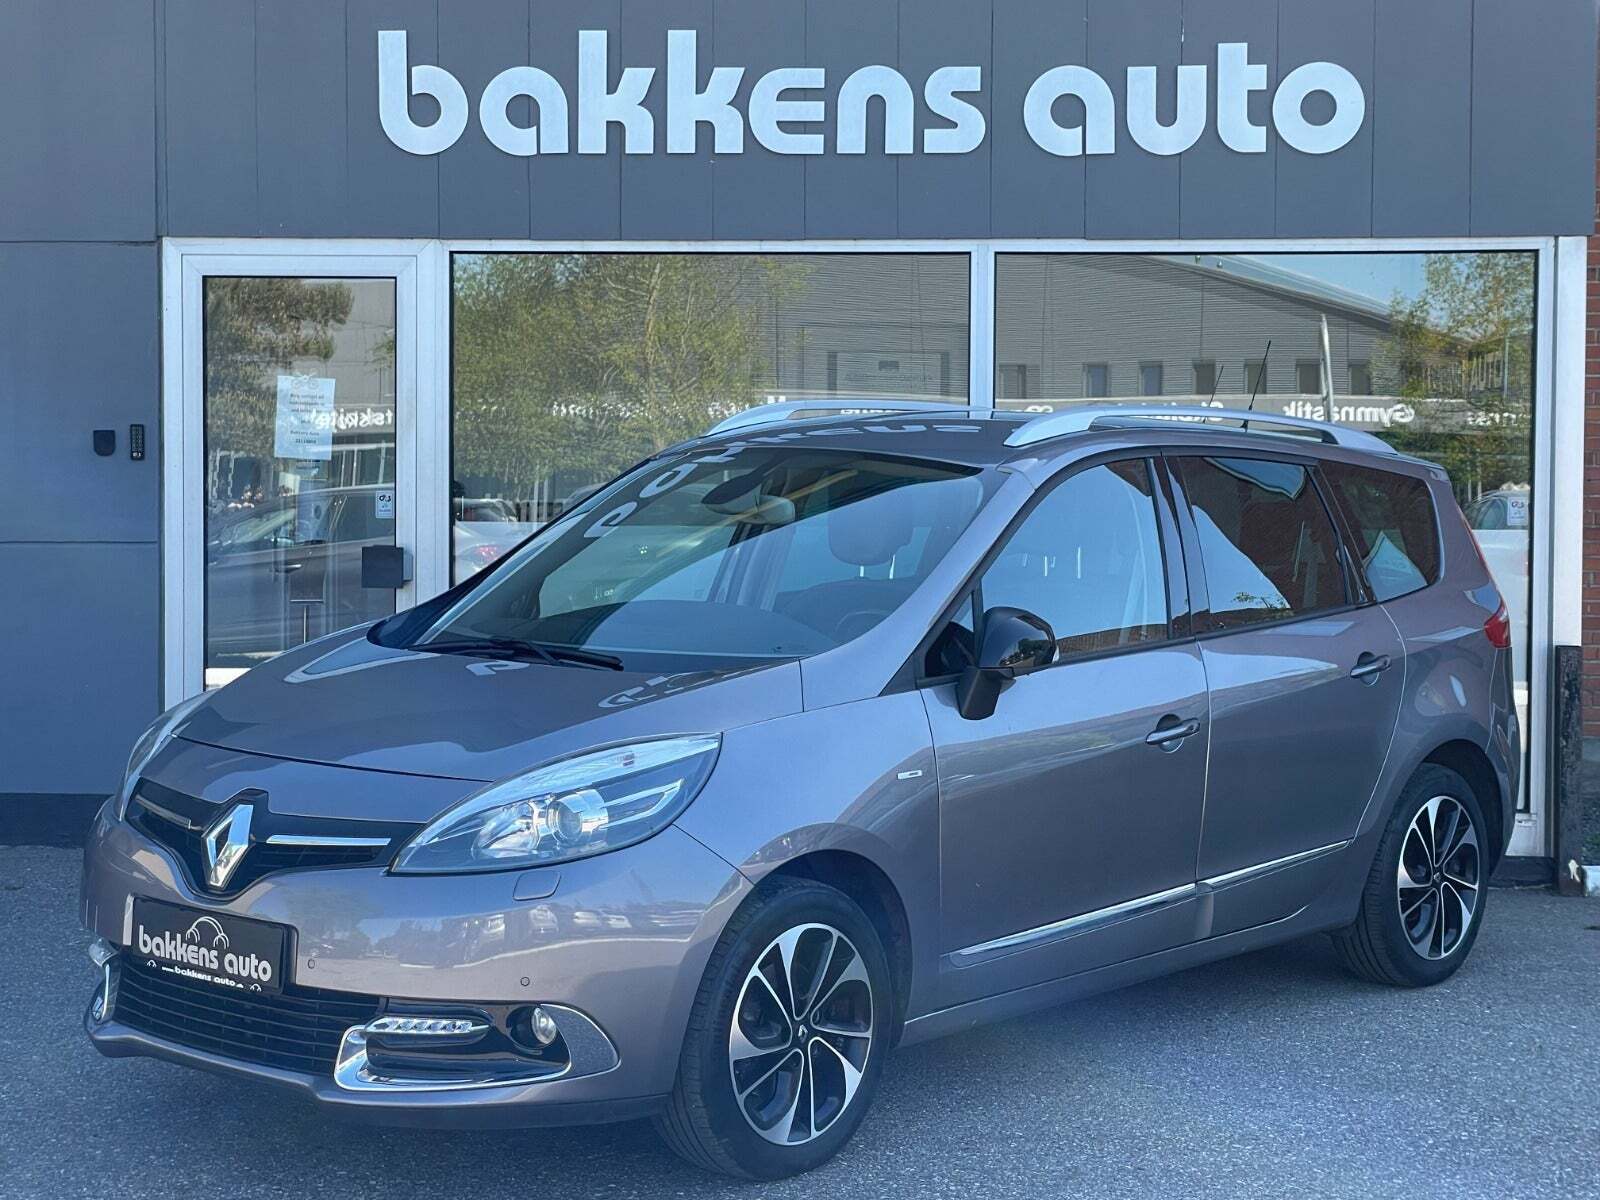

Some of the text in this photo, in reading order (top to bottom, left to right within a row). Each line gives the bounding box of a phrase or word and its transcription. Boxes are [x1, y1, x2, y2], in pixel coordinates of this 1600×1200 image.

[378, 30, 1365, 156] bakkens auto
[138, 925, 272, 982] bakkens auto
